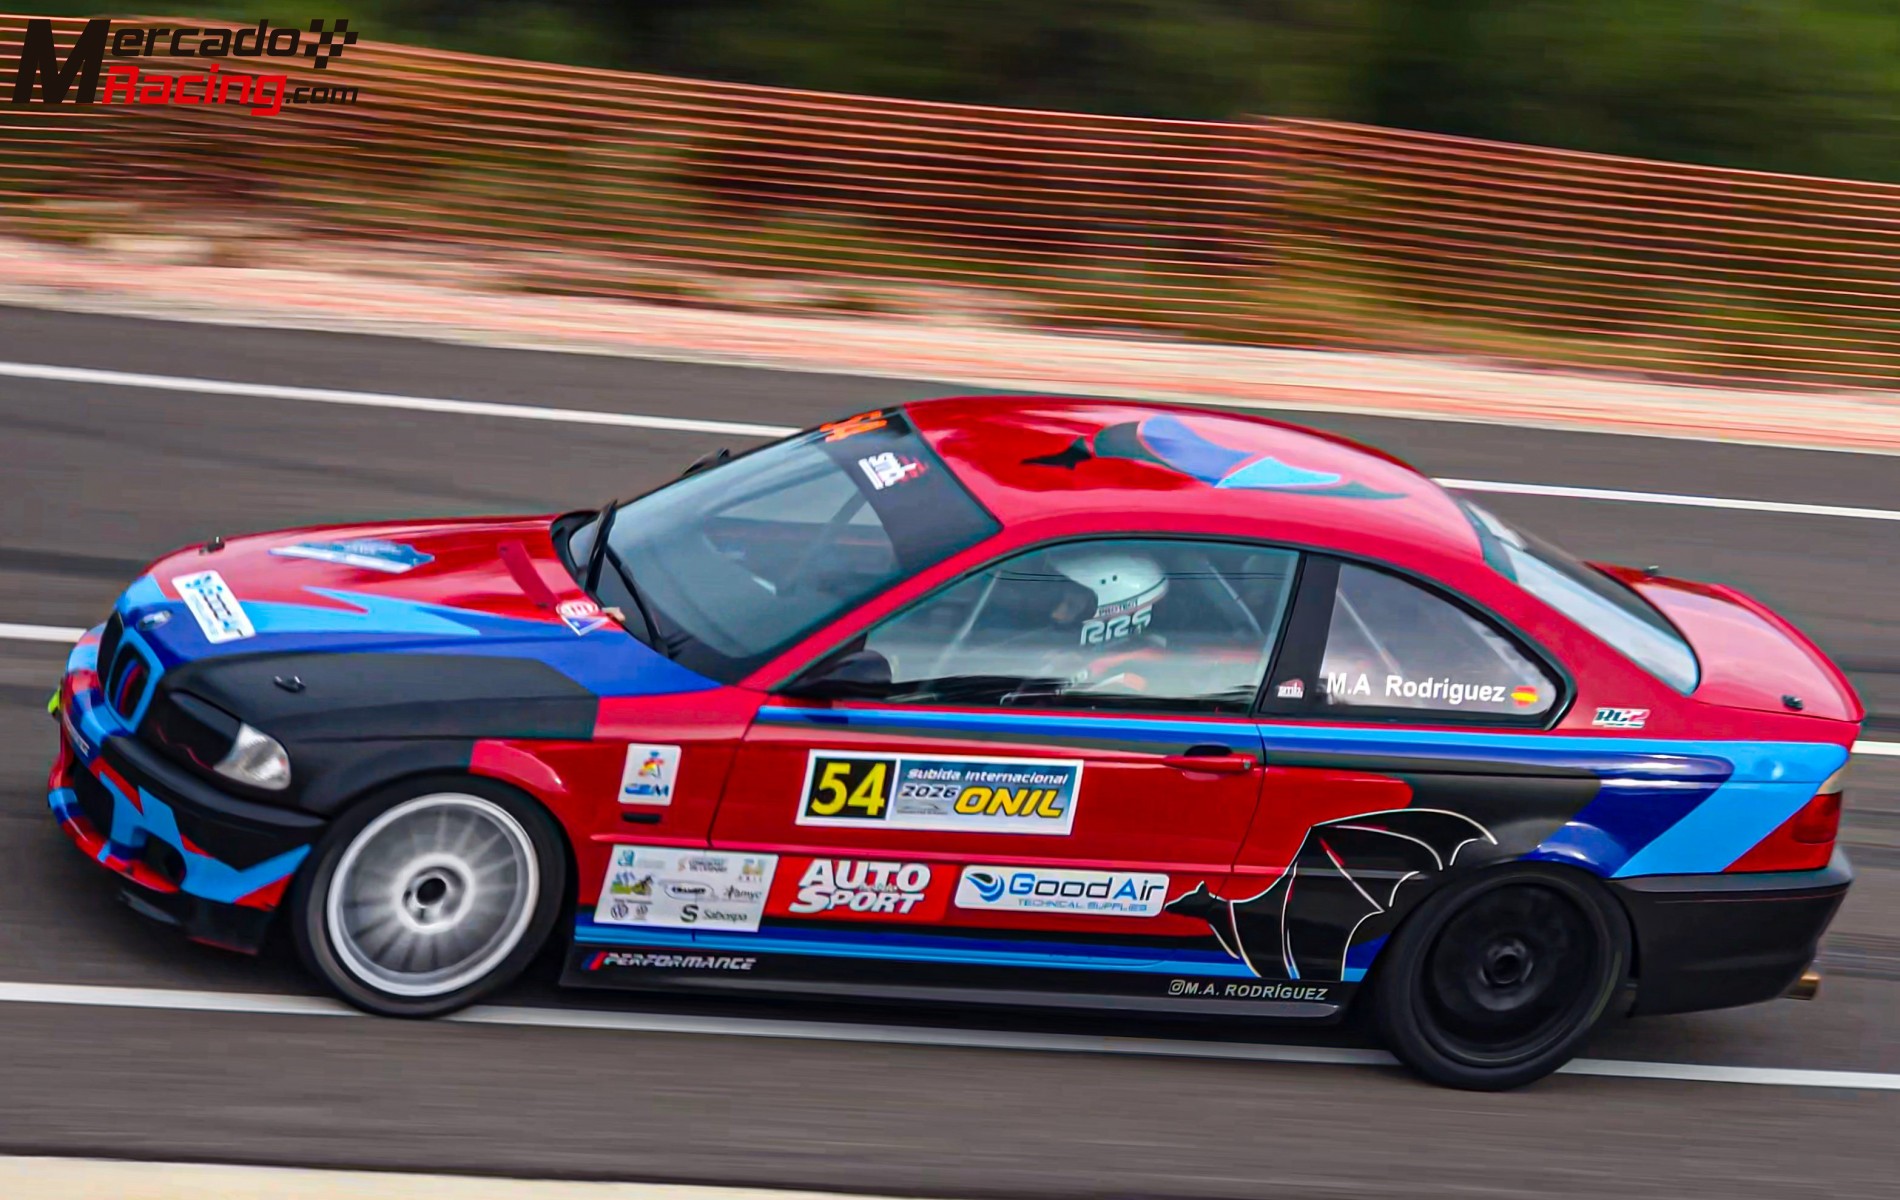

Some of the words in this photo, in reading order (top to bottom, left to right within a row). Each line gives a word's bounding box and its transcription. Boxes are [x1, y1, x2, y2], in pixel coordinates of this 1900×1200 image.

[1326, 672, 1371, 696] M.A
[1385, 675, 1506, 705] Rodriguez
[811, 763, 885, 816] 54
[965, 770, 1068, 786] Internacional
[901, 784, 959, 799] 2026
[954, 785, 1064, 818] ONIL
[798, 858, 931, 892] AUTO
[789, 885, 924, 913] SPORT
[1018, 898, 1081, 909] TECHNICAL
[1087, 901, 1147, 912] SUPPLIES
[604, 952, 756, 970] PERFORMANCE
[1184, 982, 1219, 995] M.A.
[1225, 984, 1328, 1000] RODRÍGUEZ
